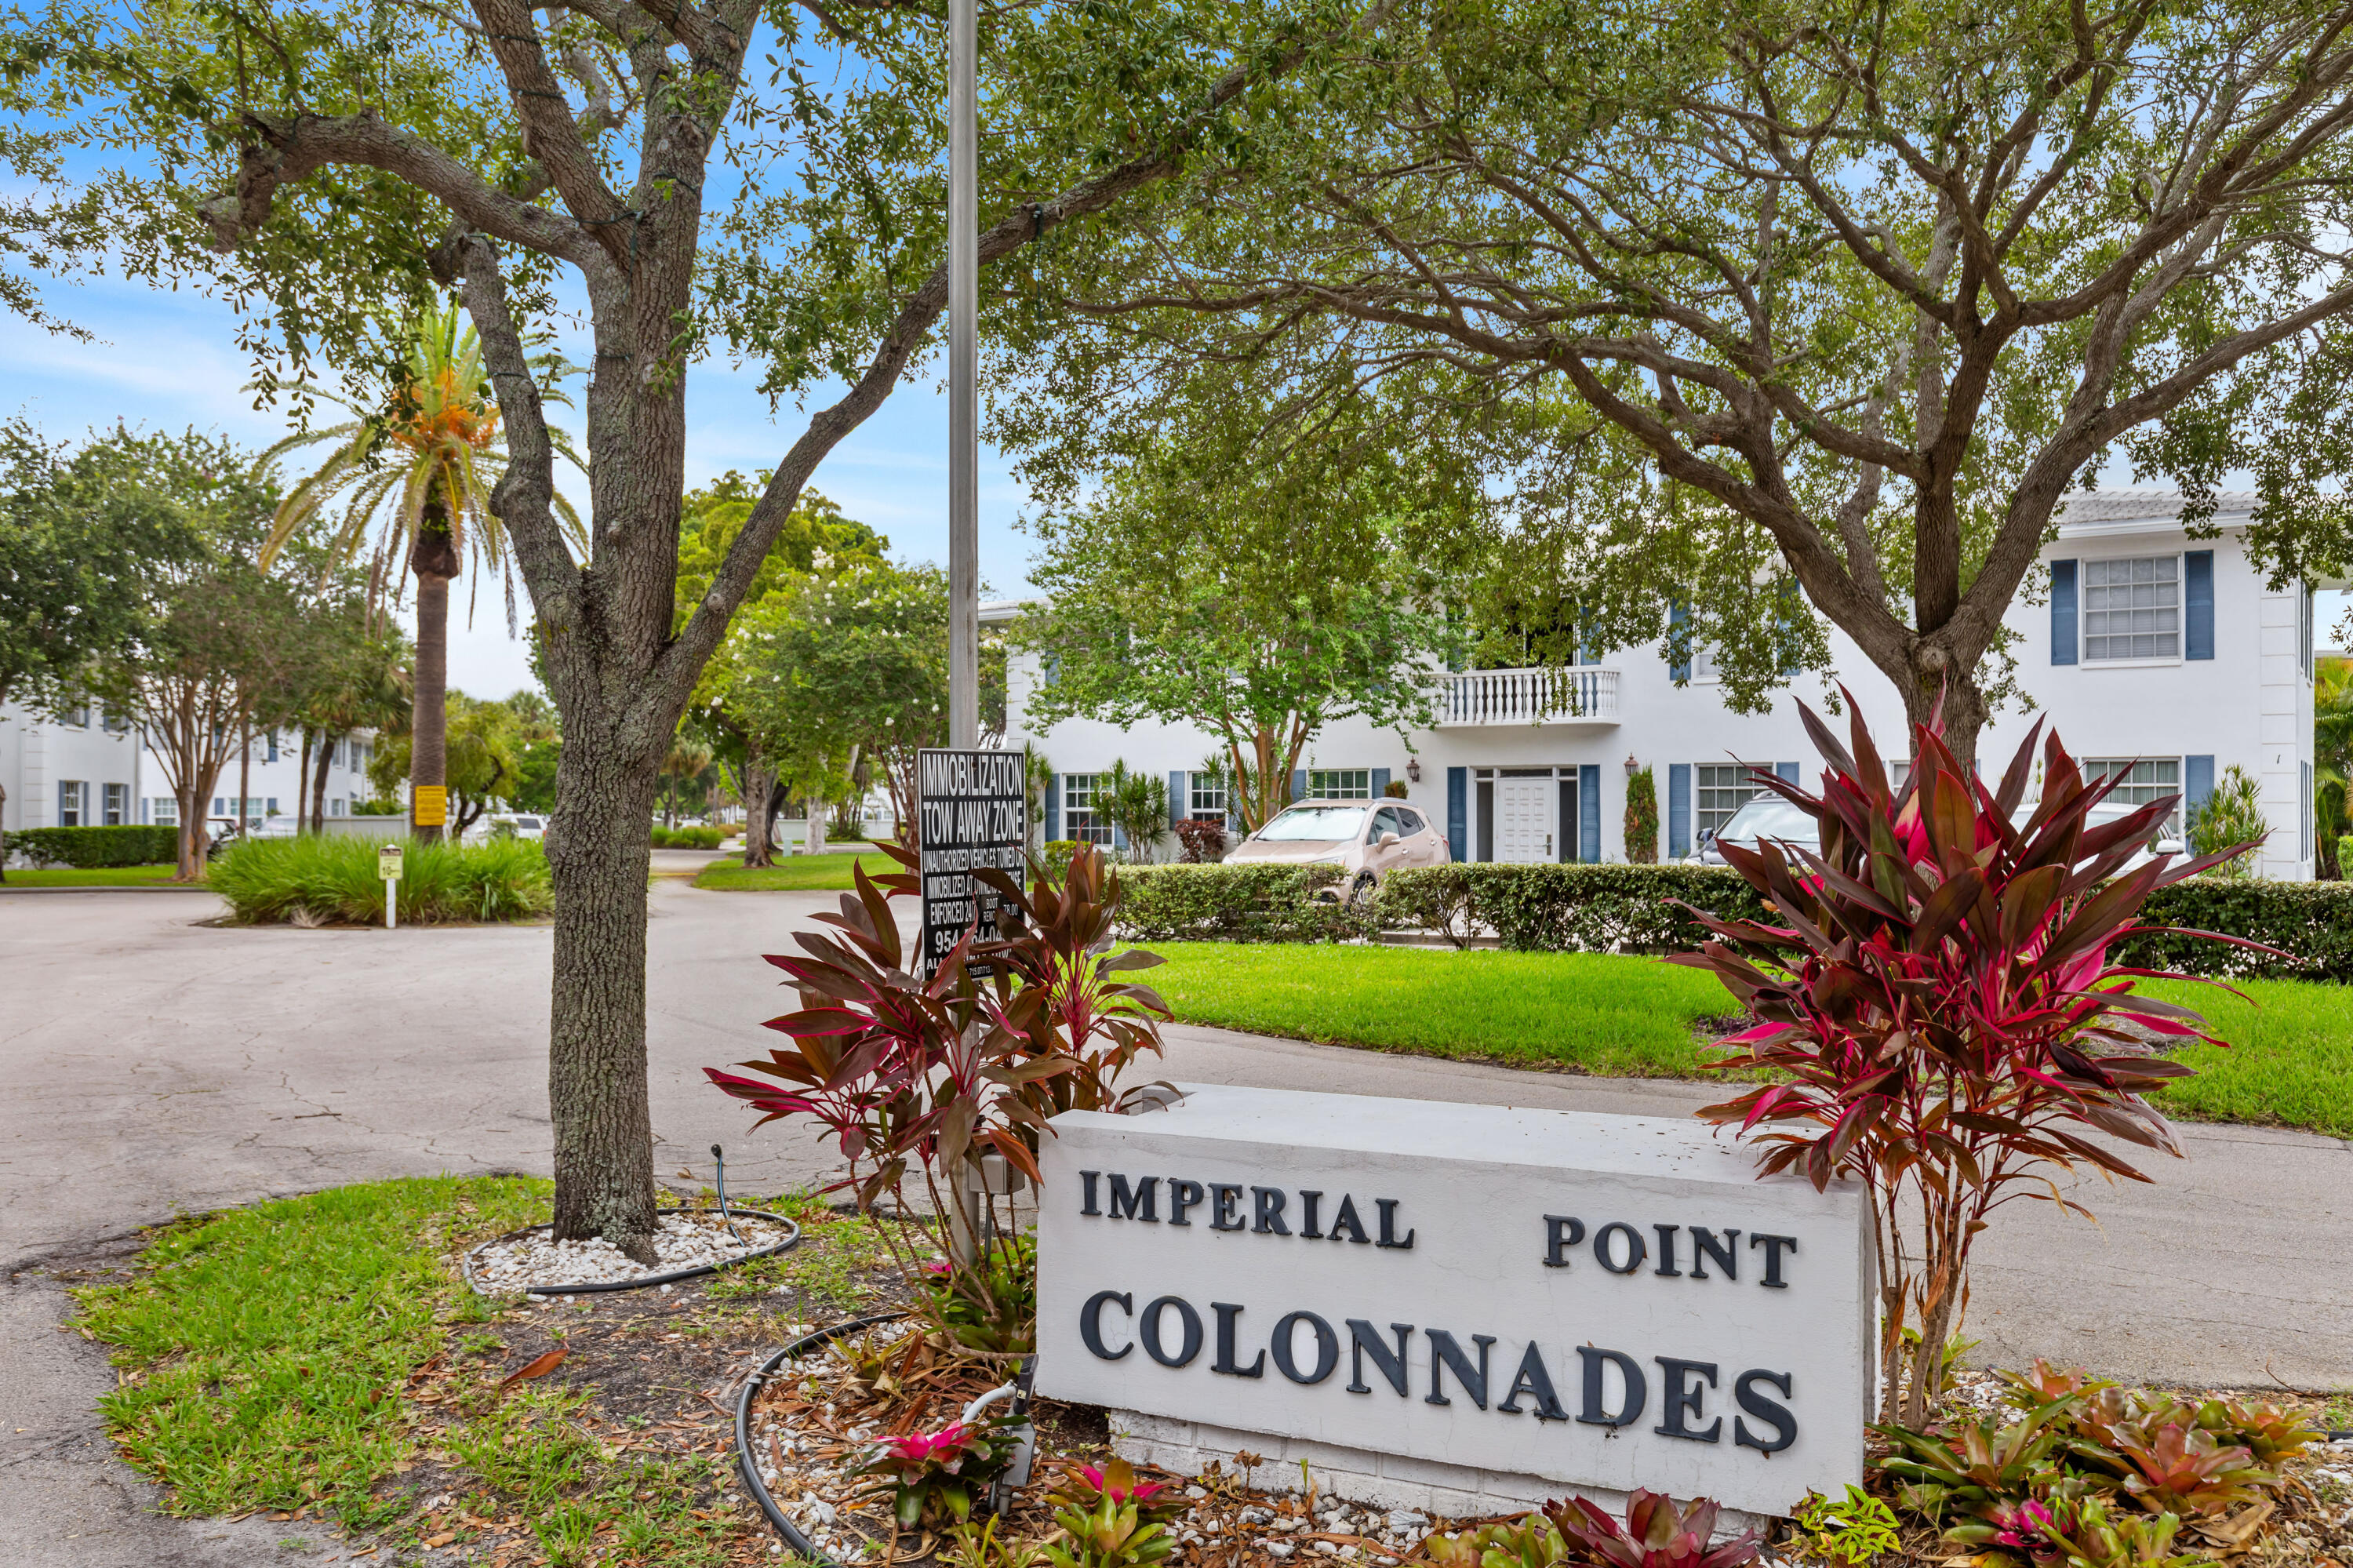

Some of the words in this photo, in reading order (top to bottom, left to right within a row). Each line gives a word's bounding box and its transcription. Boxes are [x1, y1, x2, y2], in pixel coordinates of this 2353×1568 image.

[922, 754, 1023, 796] IMMOBILIZATION
[923, 802, 954, 845] TOW
[956, 801, 991, 843] AWAY
[993, 800, 1023, 842] ZONE
[923, 849, 969, 873] UNAUTHORIZED
[969, 848, 996, 869] VEHICLES
[997, 846, 1015, 869] TOWED
[1016, 846, 1024, 867] OR
[927, 875, 966, 900] IMMOBILIZED
[966, 874, 973, 897] AT
[986, 897, 998, 910] BOOT
[930, 900, 964, 926] ENFORCED
[1078, 1169, 1415, 1250] IMPERIAL
[1542, 1213, 1798, 1289] POINT
[1079, 1290, 1798, 1453] COLONNADES
